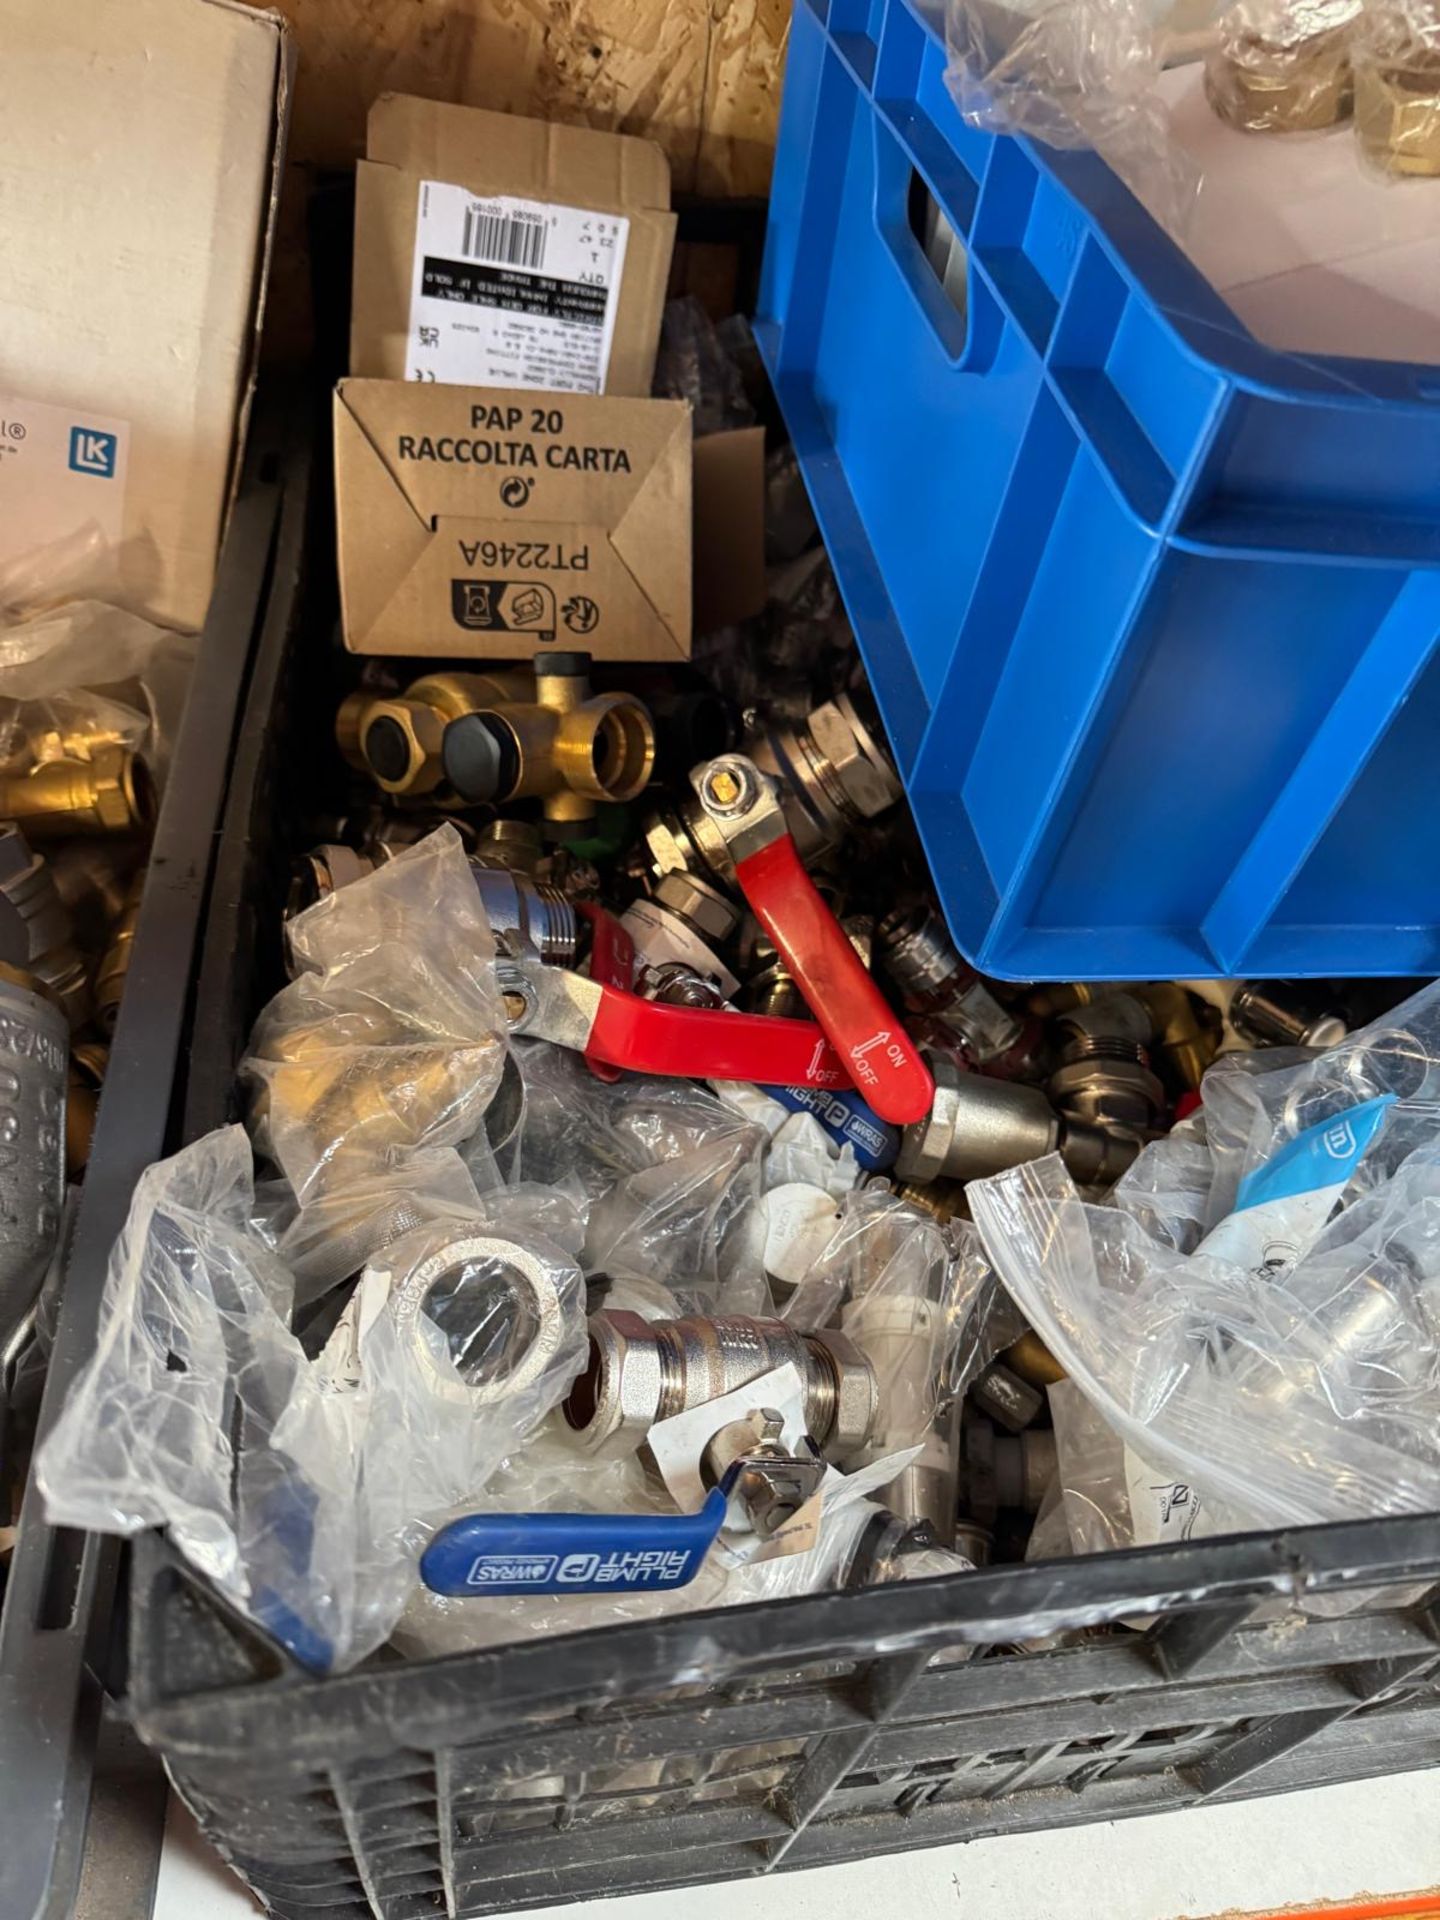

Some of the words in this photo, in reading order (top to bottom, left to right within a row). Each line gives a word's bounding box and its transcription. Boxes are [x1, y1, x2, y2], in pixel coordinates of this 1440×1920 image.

[424, 272, 452, 284] SOLD
[578, 270, 604, 284] QTY
[437, 289, 464, 301] ONLY
[419, 325, 439, 338] CA
[419, 336, 438, 348] UK
[522, 373, 544, 383] ZONE
[471, 405, 523, 431] PAP
[530, 409, 563, 434] 20
[398, 436, 537, 467] RACCOLTA
[546, 445, 631, 473] CARTA
[459, 540, 589, 571] PT2246A
[886, 1044, 908, 1069] ON
[815, 1070, 840, 1082] OFF
[855, 1060, 879, 1087] OFF
[599, 1549, 691, 1568] RIGHT
[478, 1565, 532, 1581] WRAS
[595, 1565, 683, 1583] PLUMB
